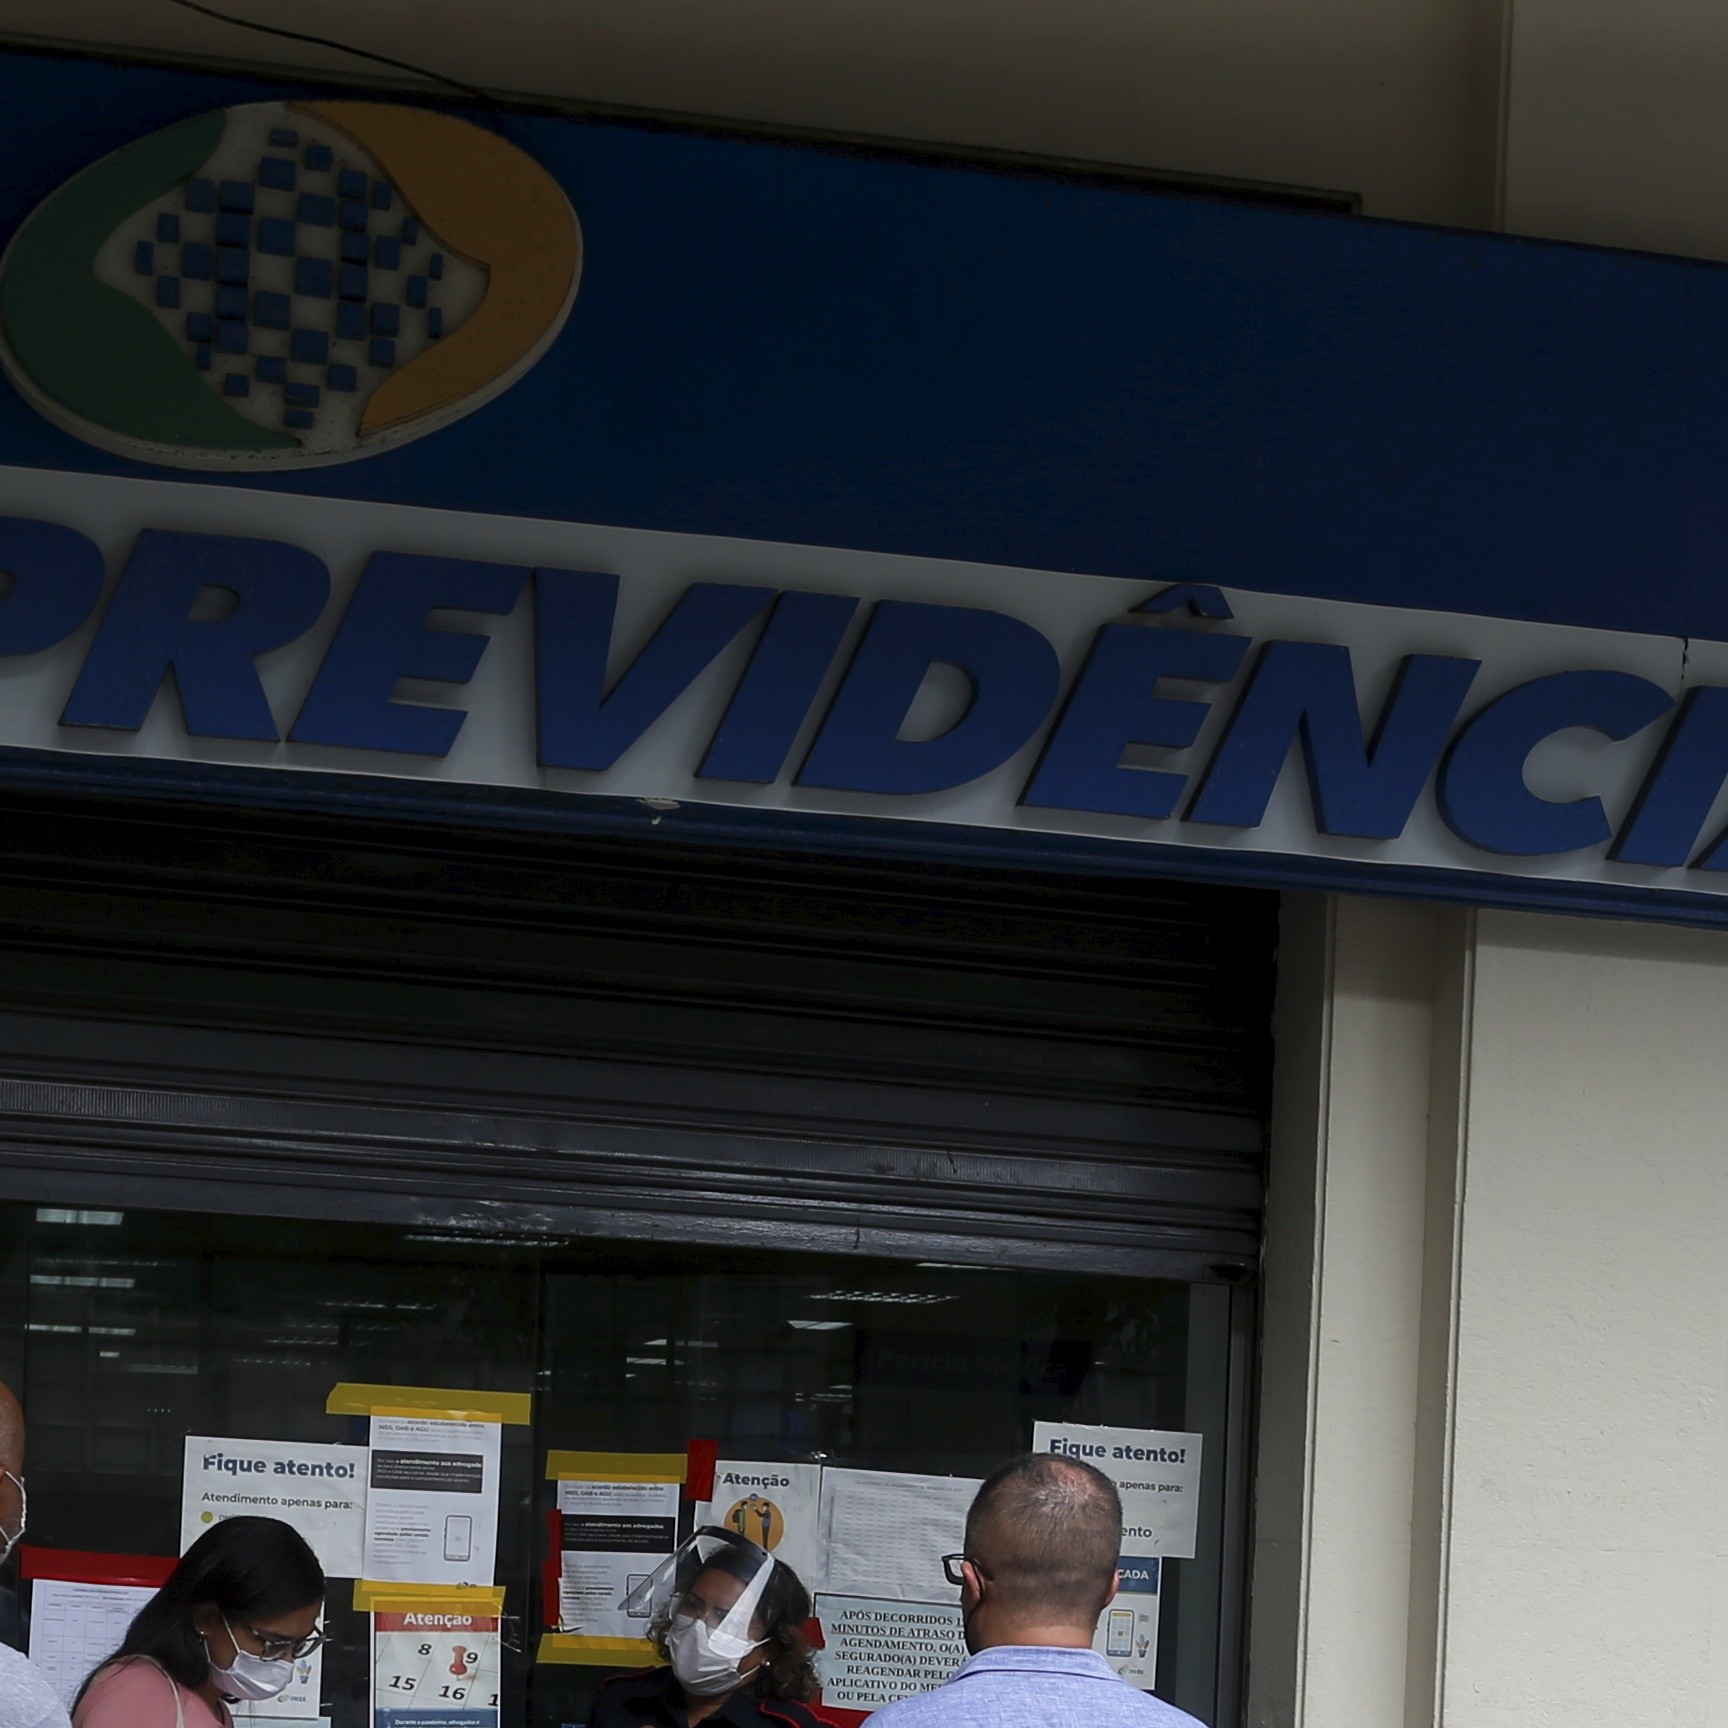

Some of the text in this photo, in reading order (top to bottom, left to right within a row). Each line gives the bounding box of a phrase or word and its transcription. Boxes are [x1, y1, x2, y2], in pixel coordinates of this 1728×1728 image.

[1049, 1437, 1186, 1464] Fique atento!
[203, 1452, 267, 1476] Fique
[273, 1459, 356, 1479] atento!
[722, 1473, 790, 1489] Atenção
[1119, 1481, 1156, 1491] apenas
[1158, 1483, 1184, 1493] para:
[201, 1491, 354, 1510] Atendimento apenas para:
[1121, 1526, 1153, 1538] ento
[1116, 1569, 1150, 1581] CADA
[840, 1609, 872, 1621] APÓS
[874, 1611, 953, 1625] DECORRIDOS
[831, 1623, 886, 1636] MINUTOS
[889, 1626, 904, 1637] DE
[907, 1628, 955, 1641] ATRASO
[417, 1643, 433, 1655] 8
[840, 1637, 965, 1655] AGENDAMENTO, O(A)
[465, 1652, 479, 1664] 9
[834, 1651, 917, 1665] SEGURADO(A)
[846, 1665, 921, 1679] REAGENDAR
[388, 1675, 417, 1691] 15
[827, 1677, 898, 1690] APLICATIVO
[900, 1681, 917, 1691] DO
[438, 1685, 467, 1701] 16
[837, 1690, 854, 1701] OU
[857, 1692, 885, 1703] PELA
